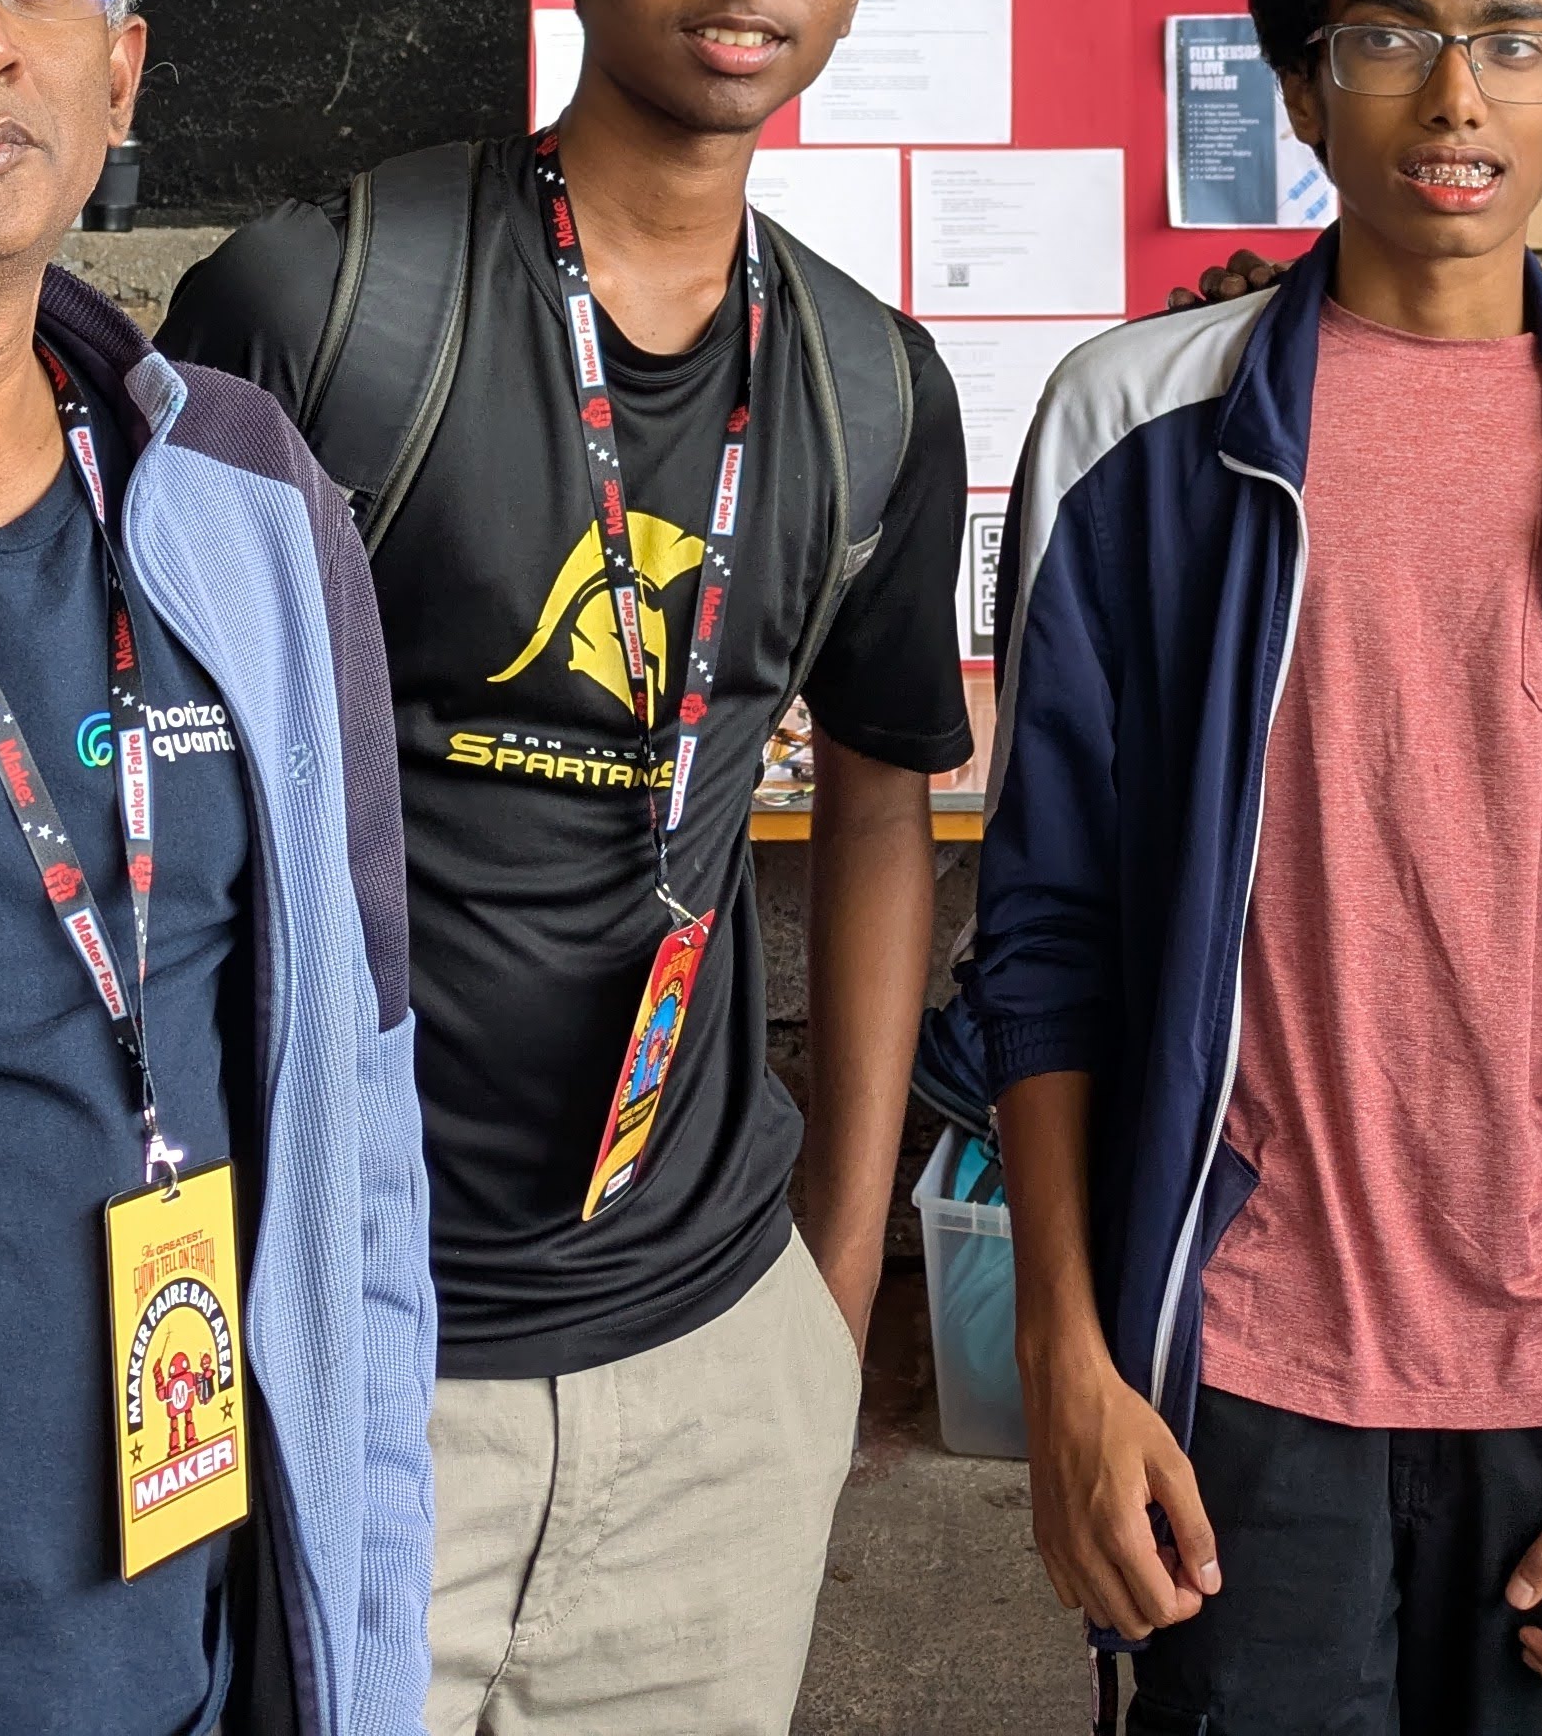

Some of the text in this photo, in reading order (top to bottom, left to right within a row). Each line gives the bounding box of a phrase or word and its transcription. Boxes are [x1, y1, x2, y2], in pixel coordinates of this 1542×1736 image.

[1189, 46, 1215, 60] FLEX
[1190, 75, 1238, 90] PROJECT
[552, 195, 576, 248] Make:
[576, 299, 598, 383] Maker Faire
[77, 430, 95, 466] Faire
[603, 479, 624, 536] Make:
[716, 448, 739, 531] Maker Faire
[621, 590, 643, 675] Maker Faire
[698, 584, 724, 642] Make:
[146, 701, 228, 731] horizo
[502, 732, 561, 750] SAN
[127, 733, 146, 835] Maker Faire
[670, 740, 693, 826] Maker Faire
[72, 914, 120, 1014] Maker Faire
[156, 1229, 203, 1255] GREATEST
[161, 1251, 178, 1277] TELL
[128, 1282, 232, 1424] MAKER FAIRE BAY AREA
[135, 1439, 233, 1510] MAKER
